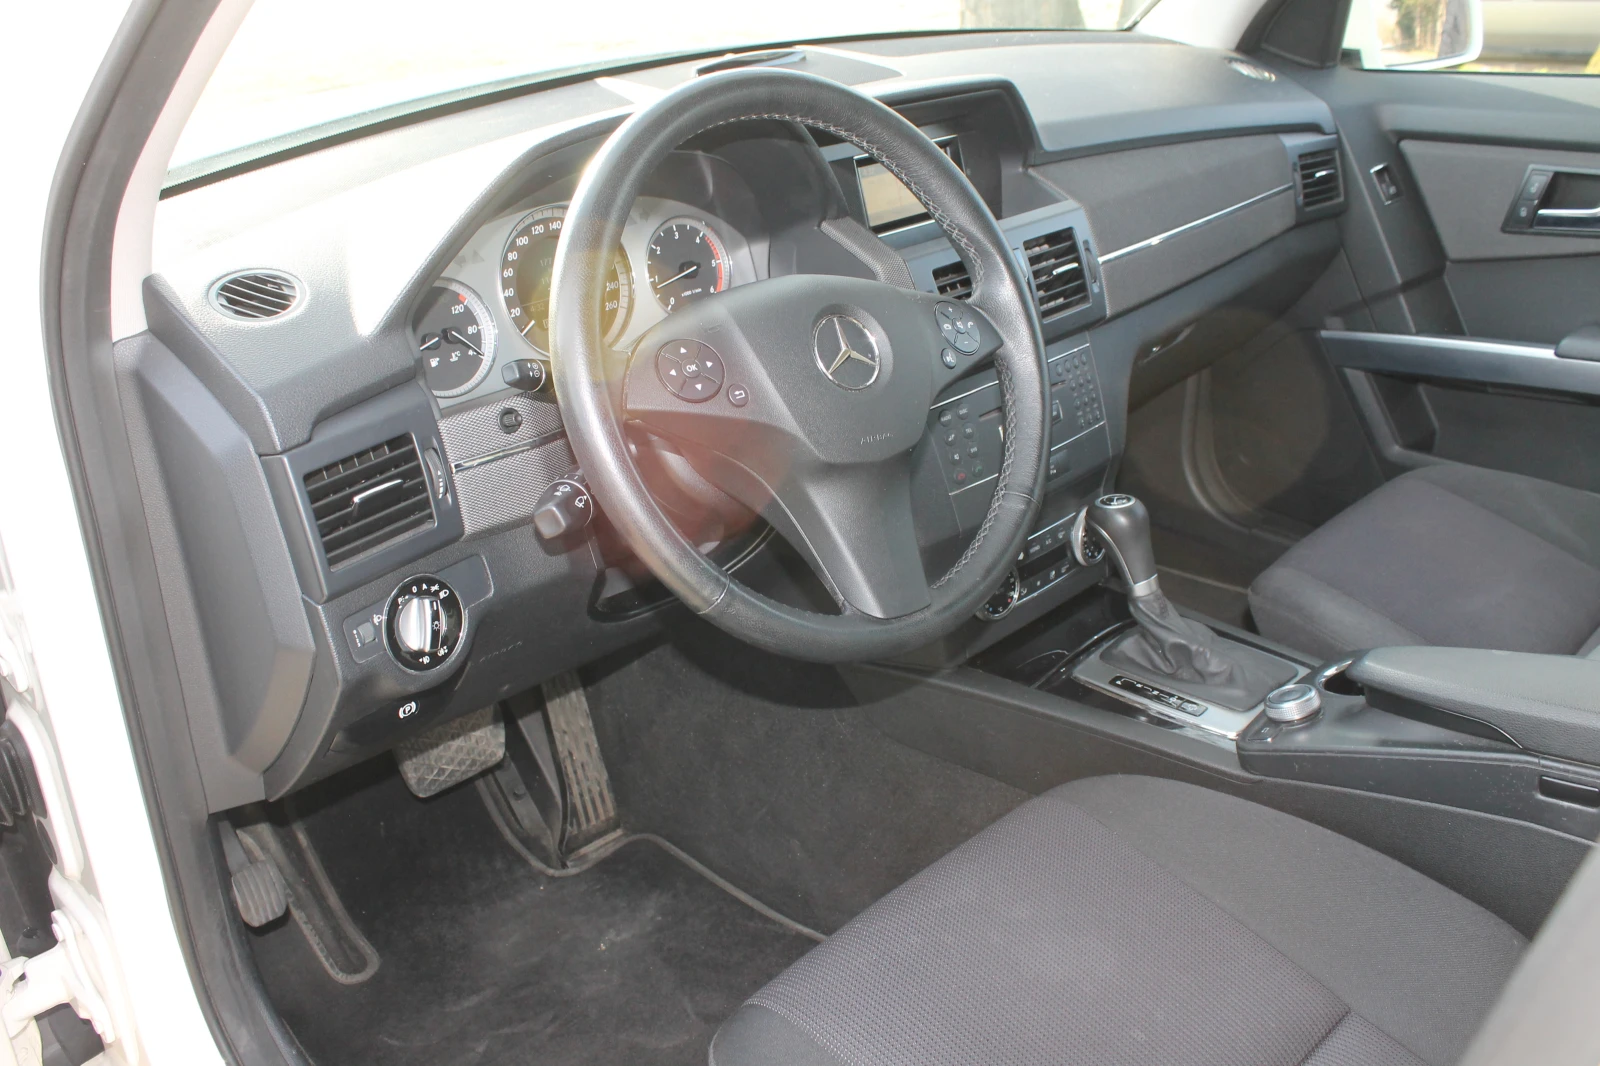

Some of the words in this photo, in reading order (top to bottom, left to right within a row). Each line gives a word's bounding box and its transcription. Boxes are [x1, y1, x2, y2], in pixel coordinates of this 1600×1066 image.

[531, 224, 544, 236] 120
[549, 221, 562, 231] 140
[674, 231, 679, 240] 3
[695, 236, 700, 244] 4
[515, 235, 529, 247] 100
[656, 246, 661, 255] 2
[507, 251, 518, 261] 80
[711, 259, 716, 267] 5
[503, 268, 514, 278] 60
[503, 288, 514, 298] 40
[710, 285, 715, 294] 6
[604, 300, 618, 311] 260
[670, 297, 675, 305] 0
[451, 304, 465, 315] 120
[510, 307, 520, 318] 20
[467, 324, 478, 335] 80
[686, 363, 699, 372] OK
